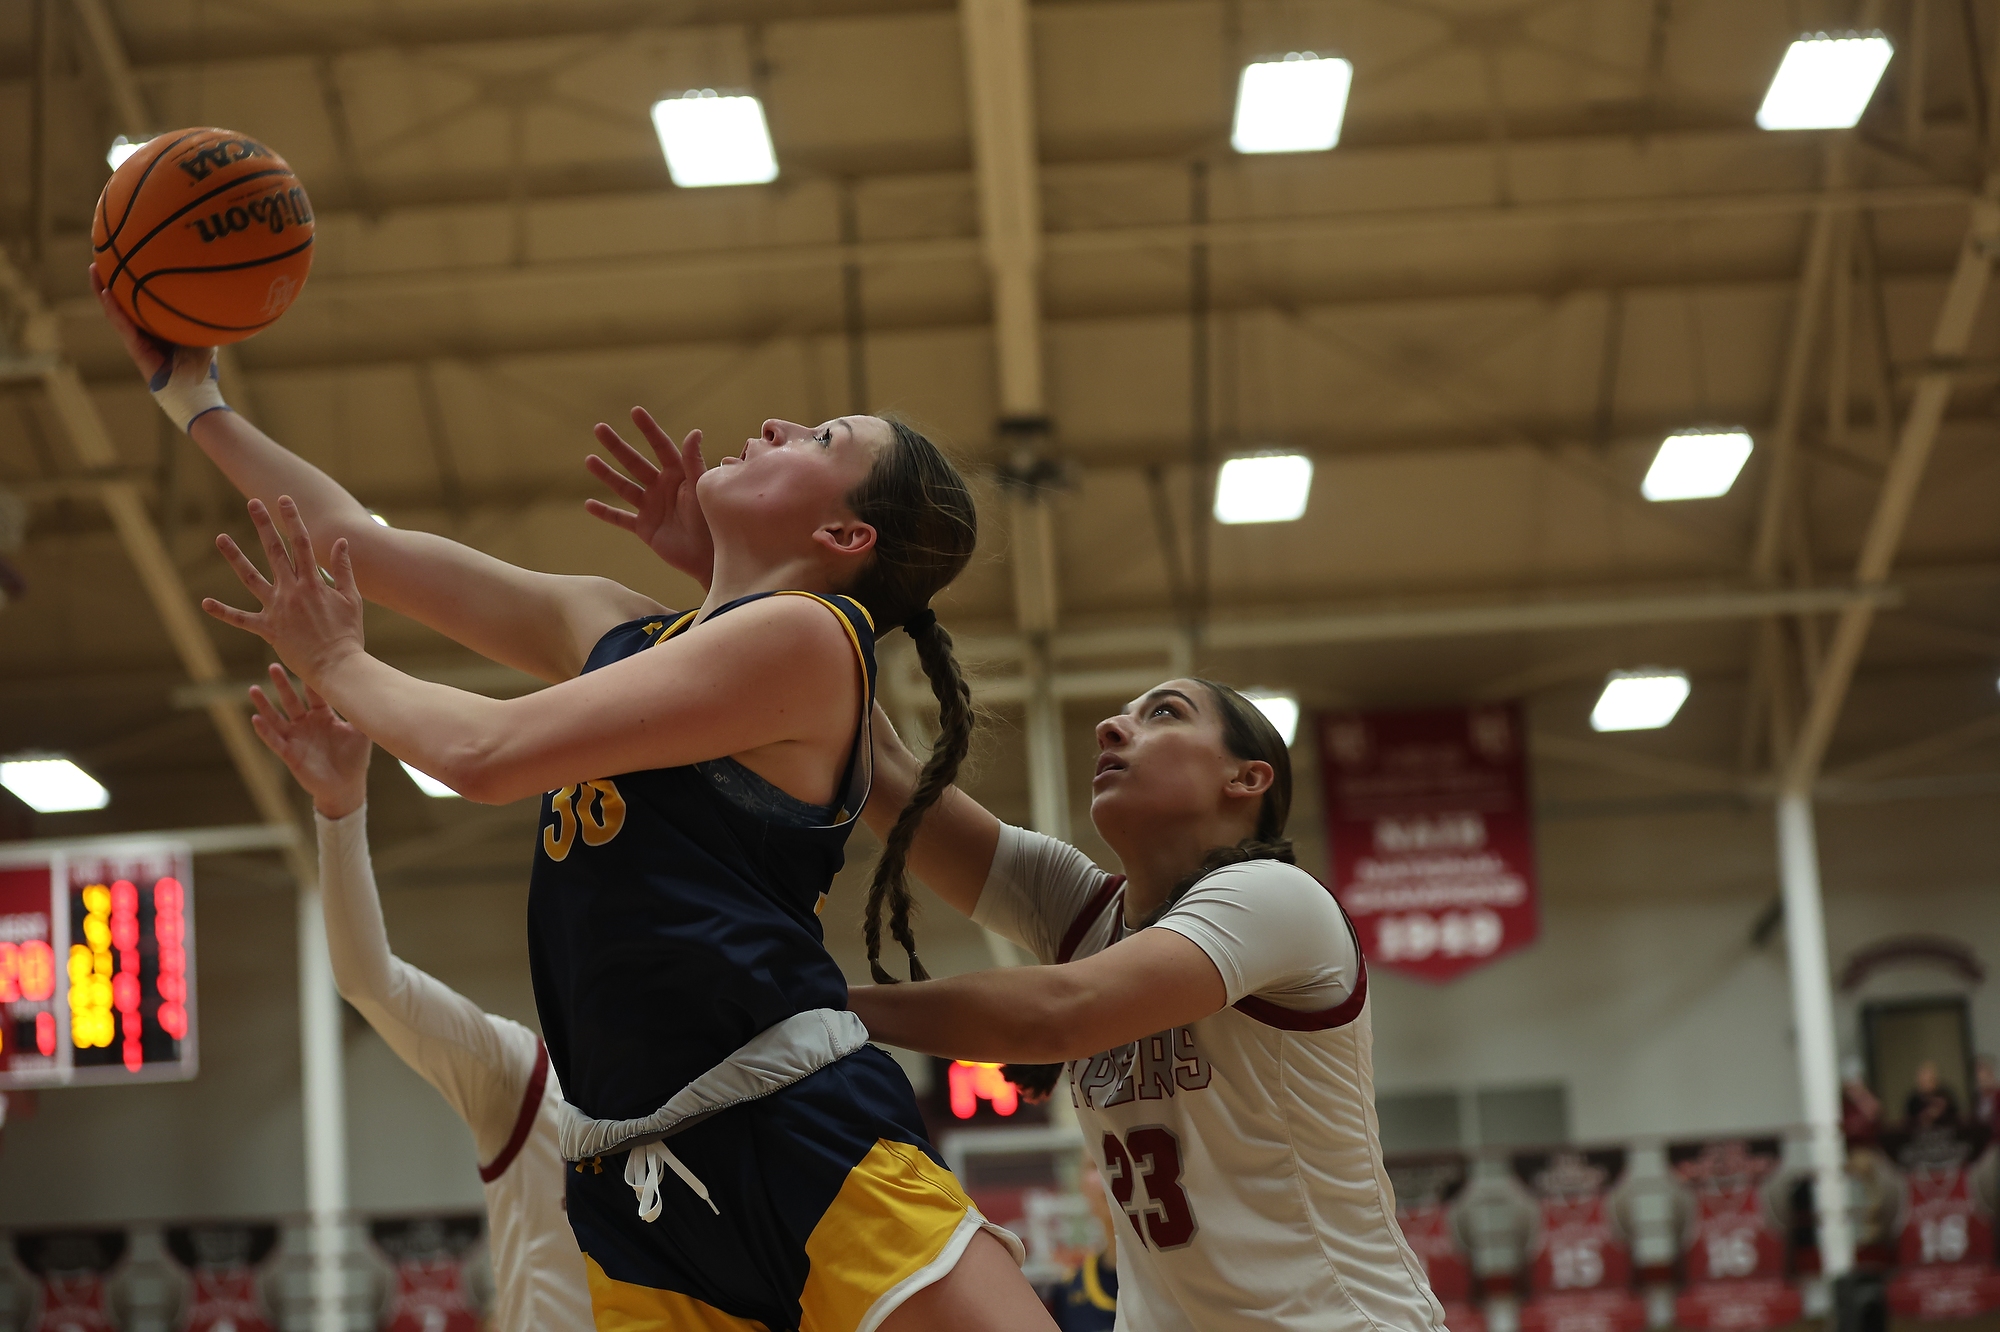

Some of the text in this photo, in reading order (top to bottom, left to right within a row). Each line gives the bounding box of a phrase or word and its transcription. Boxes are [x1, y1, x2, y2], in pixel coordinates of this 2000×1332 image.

[189, 187, 312, 243] Wilson
[543, 780, 627, 862] 30
[1101, 1124, 1199, 1252] 23
